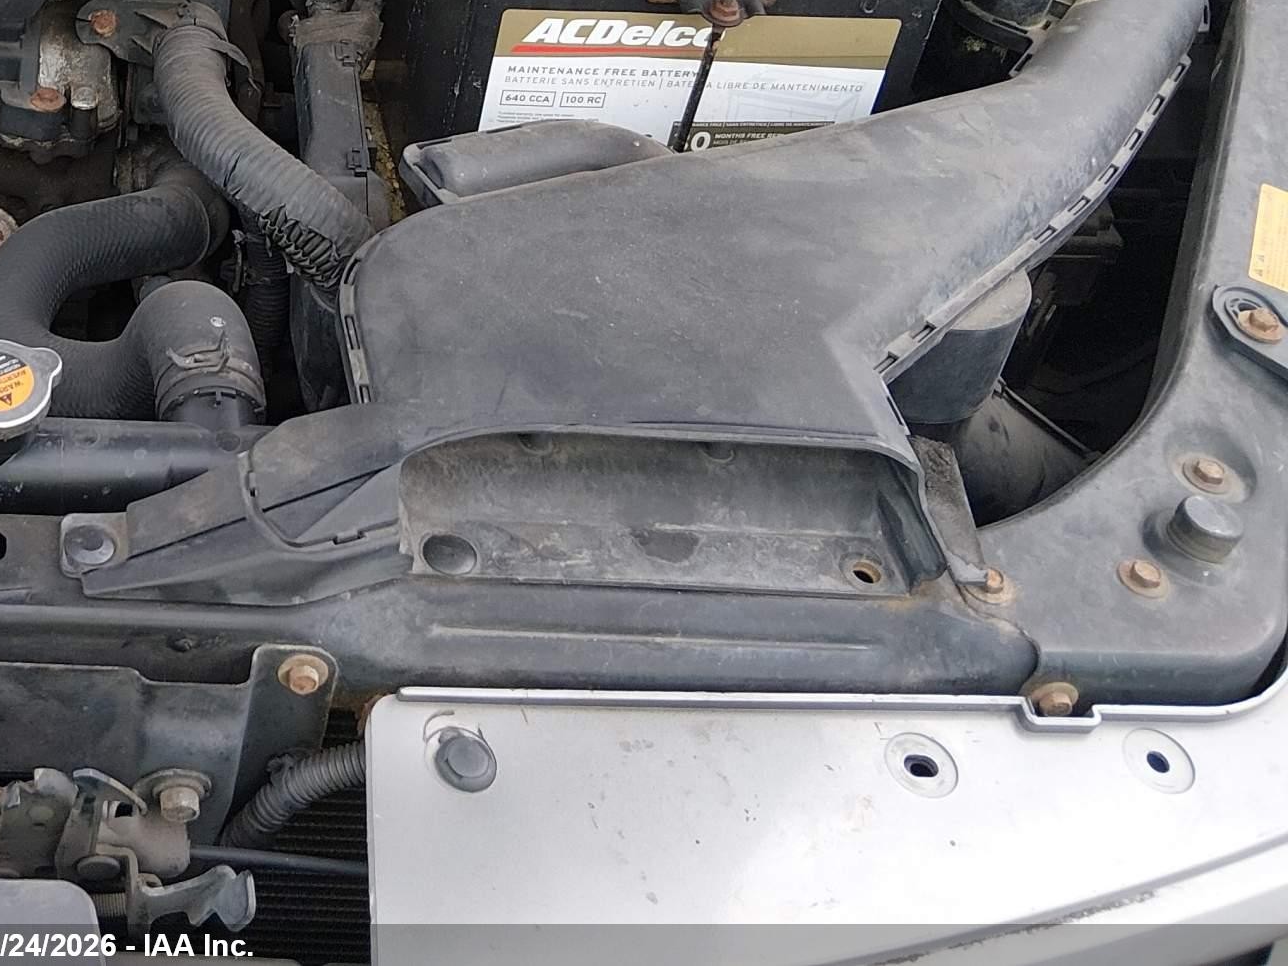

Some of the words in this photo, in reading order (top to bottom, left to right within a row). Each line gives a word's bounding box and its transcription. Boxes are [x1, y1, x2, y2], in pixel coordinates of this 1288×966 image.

[507, 65, 599, 76] MAINTENANCE
[604, 68, 637, 76] FREE
[641, 69, 699, 78] BATTERY
[505, 76, 556, 85] BATTERIE
[561, 78, 590, 86] SANS
[593, 78, 656, 87] ENTRETIEN
[716, 82, 747, 90] LIBRE
[752, 82, 766, 90] DE
[770, 83, 863, 92] MANTENIMIENTO
[505, 94, 526, 103] 640
[529, 95, 550, 103] CCA
[565, 96, 584, 104] 100
[587, 96, 602, 104] RC
